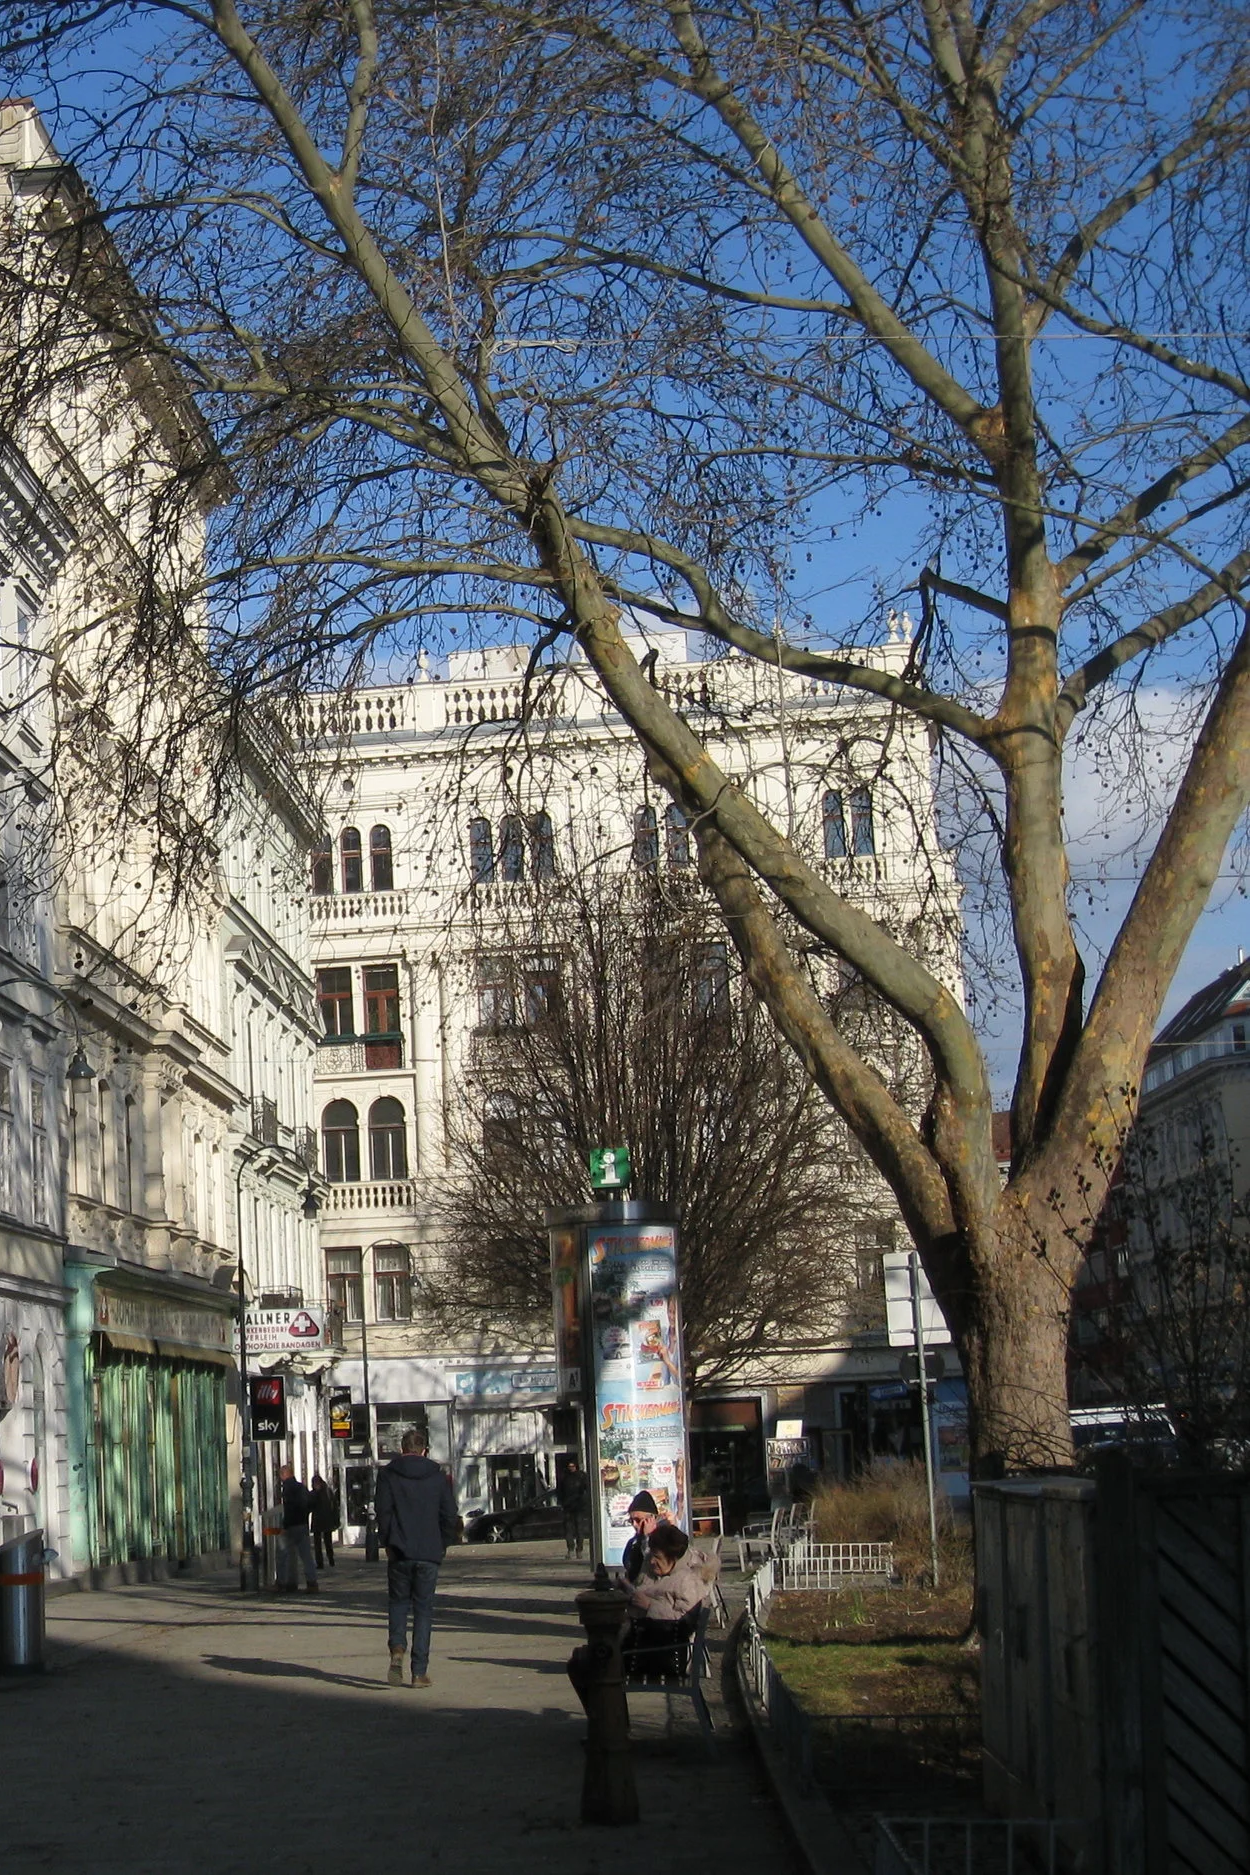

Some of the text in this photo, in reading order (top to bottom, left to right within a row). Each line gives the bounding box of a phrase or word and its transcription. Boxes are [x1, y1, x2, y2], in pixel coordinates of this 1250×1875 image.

[245, 1333, 277, 1341] VERLEIH
[281, 1341, 321, 1349] BANDAGEN
[257, 1384, 279, 1400] illy
[257, 1419, 279, 1433] sky
